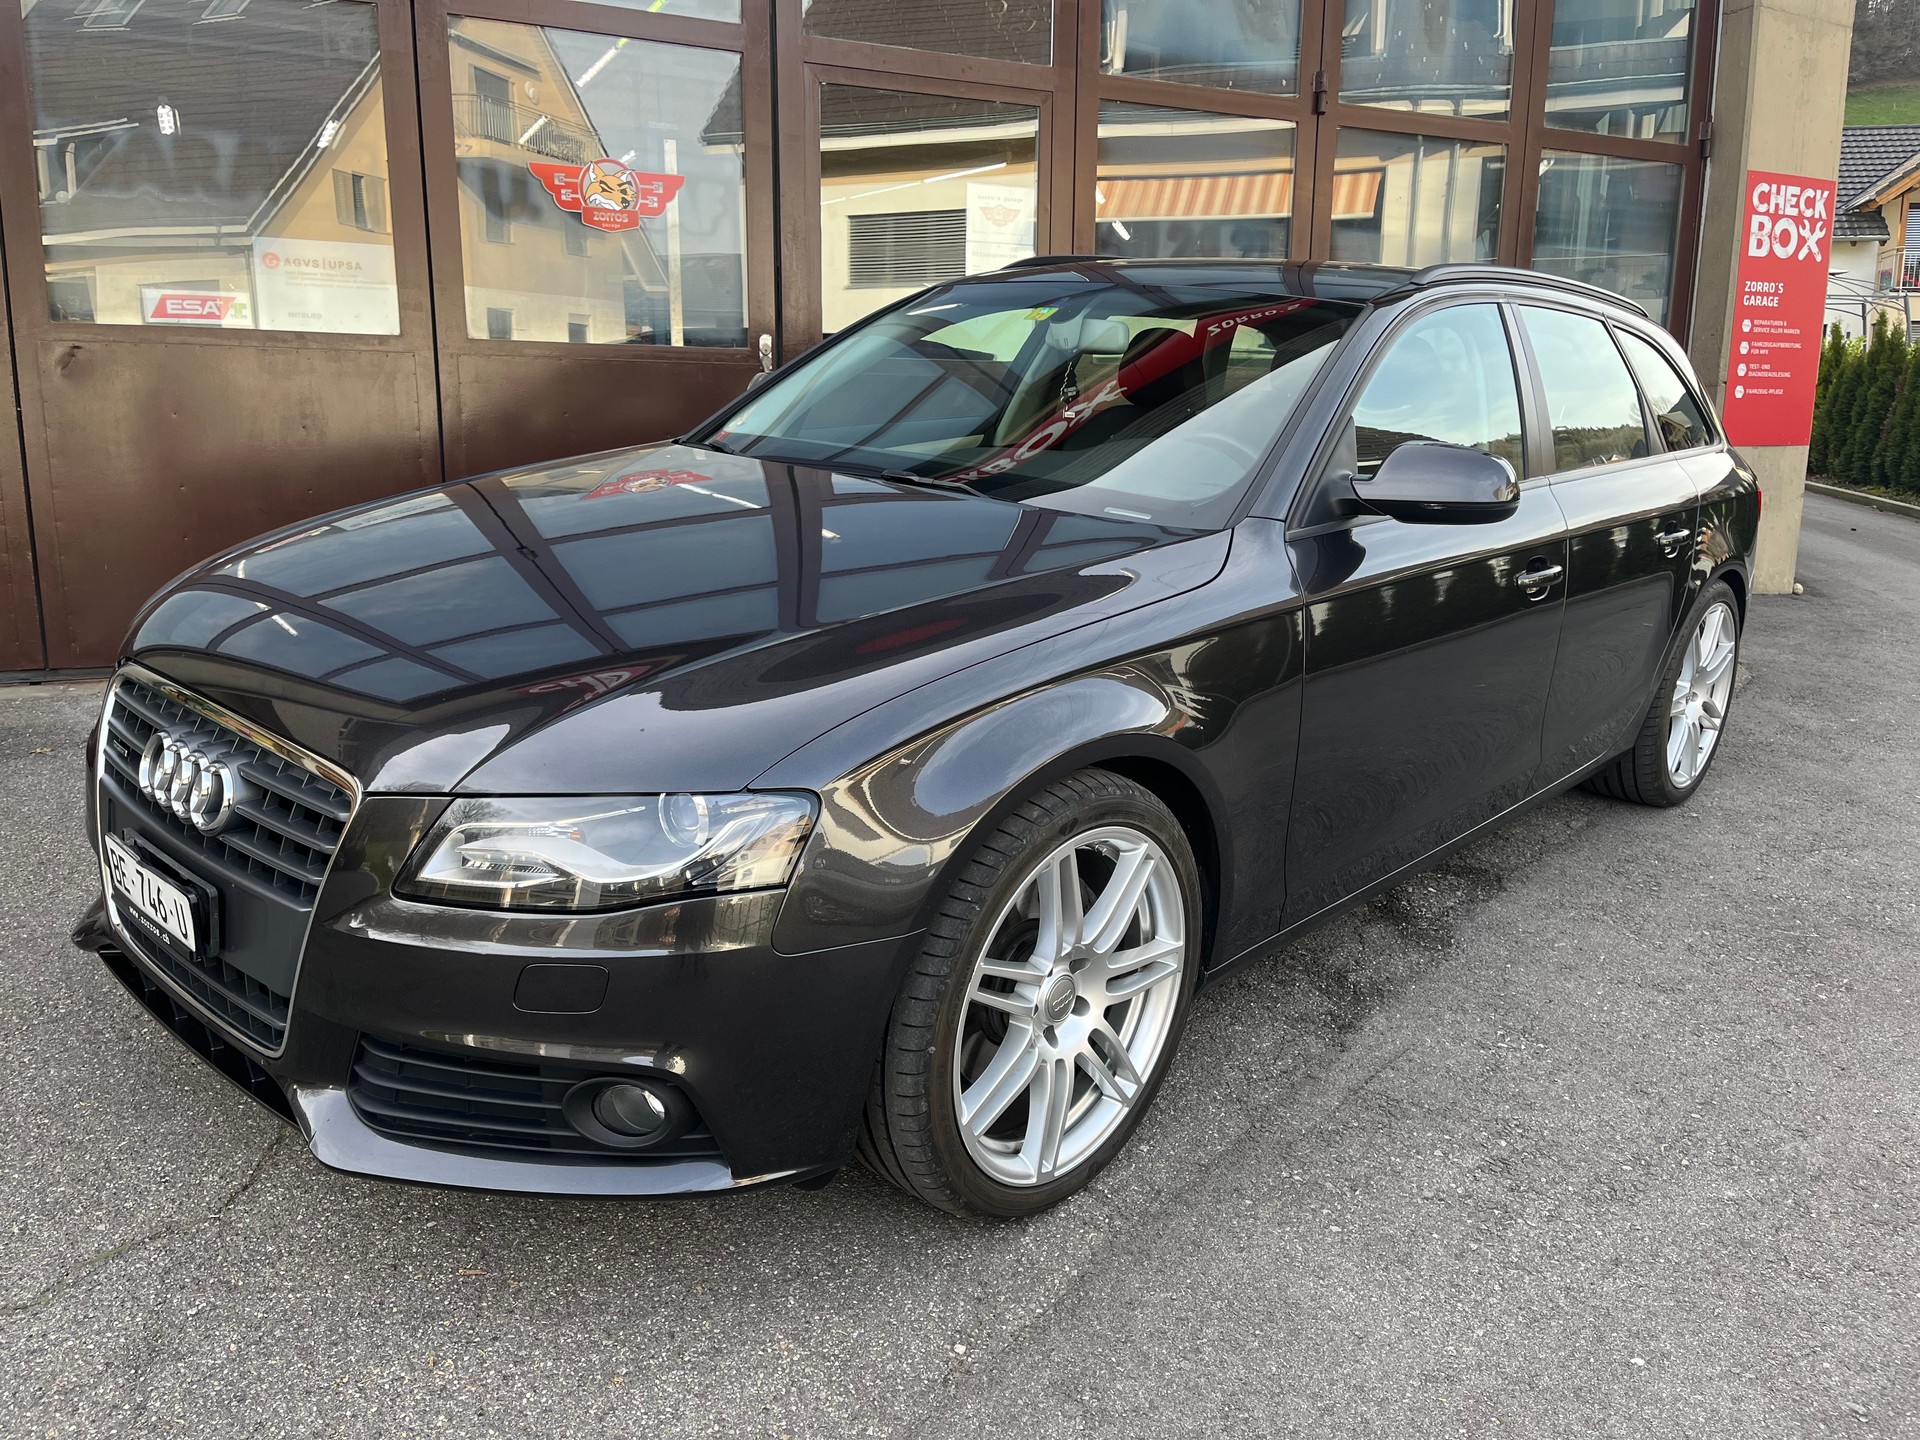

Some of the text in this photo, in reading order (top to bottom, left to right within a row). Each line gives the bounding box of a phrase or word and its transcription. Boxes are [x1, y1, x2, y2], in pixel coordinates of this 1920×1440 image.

[1752, 182, 1830, 220] CHECK
[593, 211, 629, 223] zorros
[1748, 214, 1827, 262] BOX
[328, 259, 362, 271] UPSA
[165, 299, 221, 315] ESA
[1743, 295, 1779, 307] GARAGE
